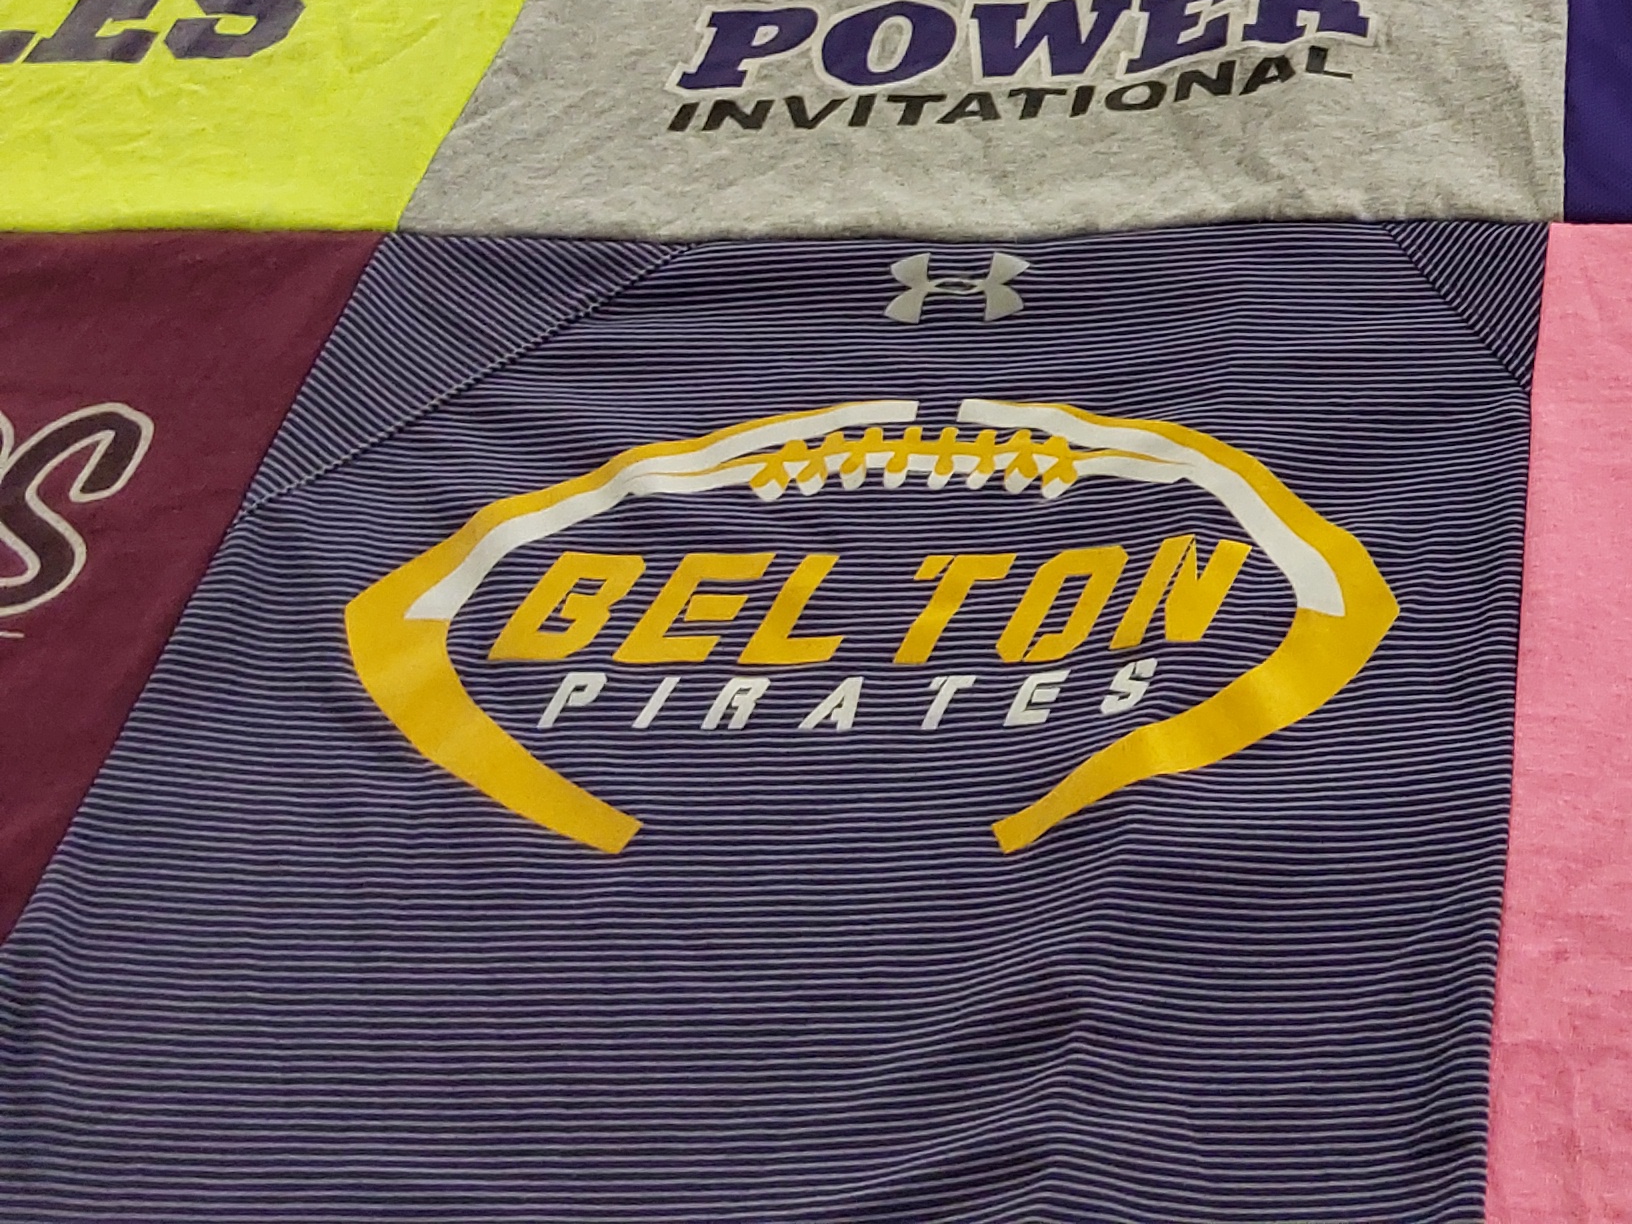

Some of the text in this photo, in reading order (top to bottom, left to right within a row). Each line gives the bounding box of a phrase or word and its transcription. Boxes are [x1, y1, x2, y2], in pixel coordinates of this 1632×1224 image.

[666, 45, 1354, 134] INVITATIONAL
[485, 533, 1254, 667] BELTON
[535, 656, 1158, 732] PIRATES
